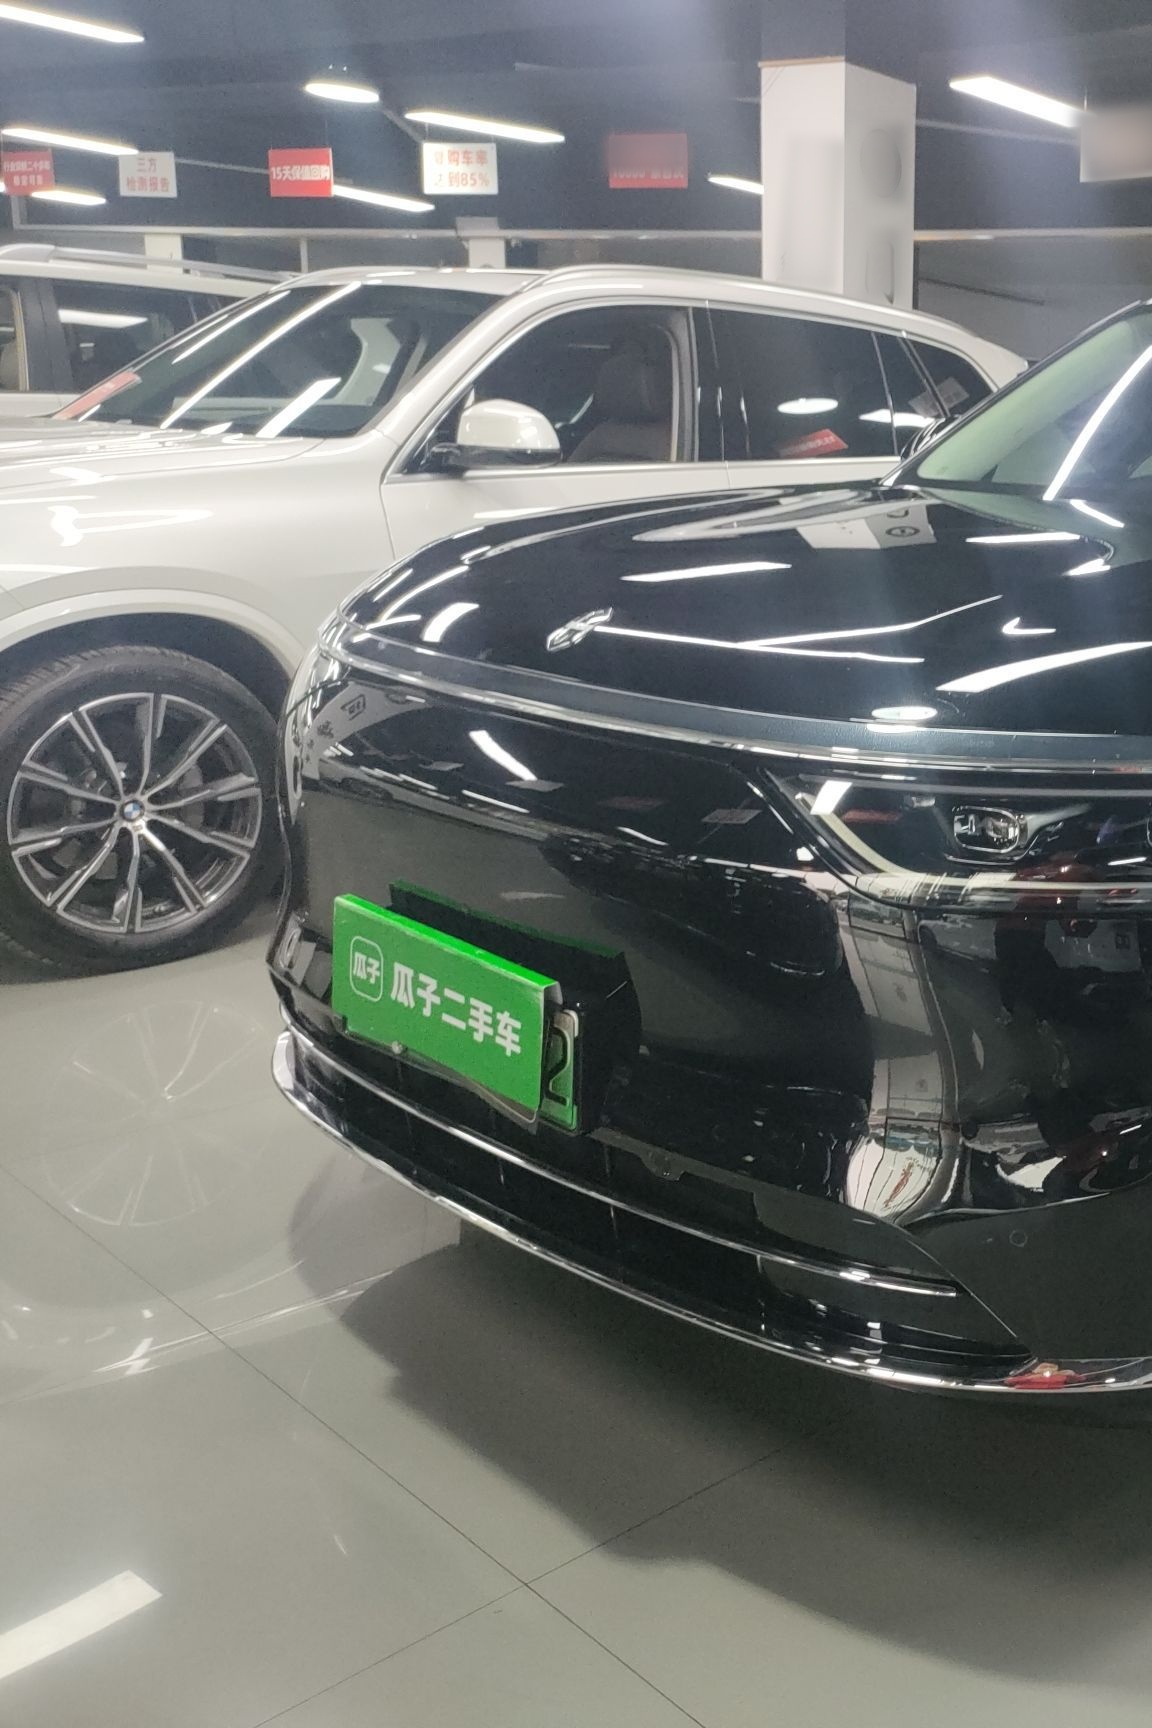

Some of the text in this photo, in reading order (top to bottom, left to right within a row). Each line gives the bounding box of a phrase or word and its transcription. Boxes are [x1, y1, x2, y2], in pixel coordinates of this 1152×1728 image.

[136, 157, 158, 173] 三方
[271, 165, 330, 181] 15天保值回购
[353, 952, 381, 984] 瓜子
[391, 961, 521, 1057] 瓜子二手车
